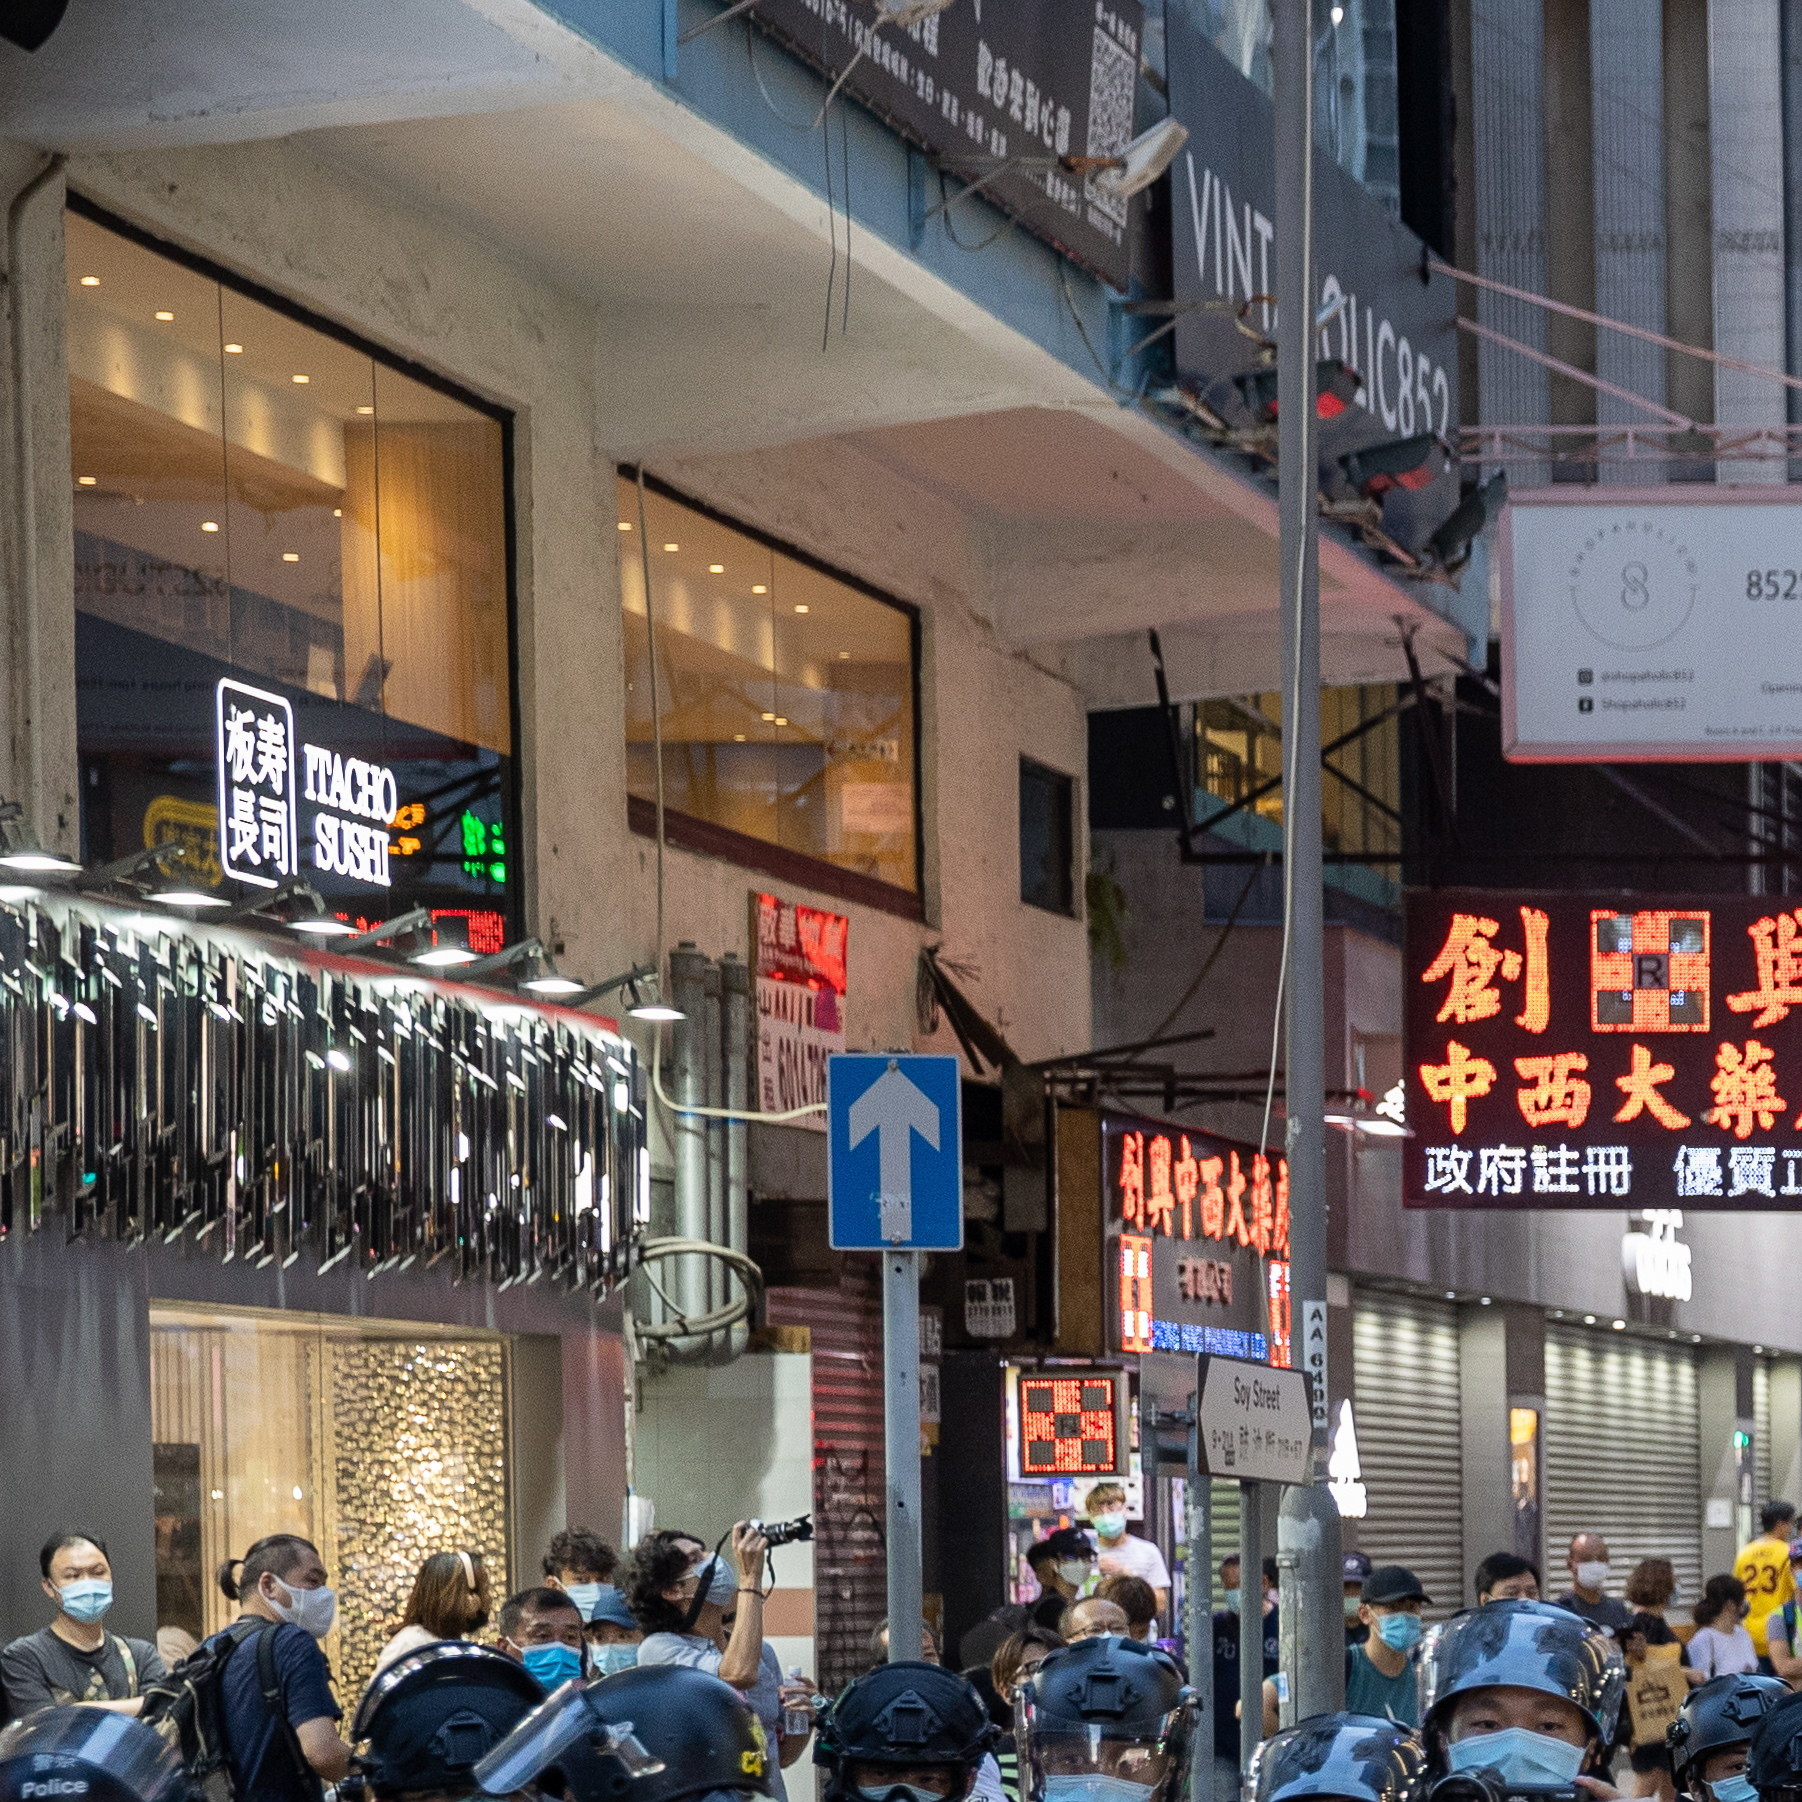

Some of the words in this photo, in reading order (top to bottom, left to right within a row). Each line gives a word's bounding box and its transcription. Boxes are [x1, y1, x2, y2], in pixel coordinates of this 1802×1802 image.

[225, 704, 261, 865] 板長
[304, 743, 397, 824] ITACHO
[314, 812, 391, 887] SUSHI
[1422, 907, 1550, 1033] 創
[1424, 1144, 1632, 1195] 政府註冊
[1234, 1375, 1251, 1412] Soy
[1252, 1379, 1281, 1412] Street
[1744, 1564, 1778, 1594] 23
[21, 1778, 89, 1799] Police
